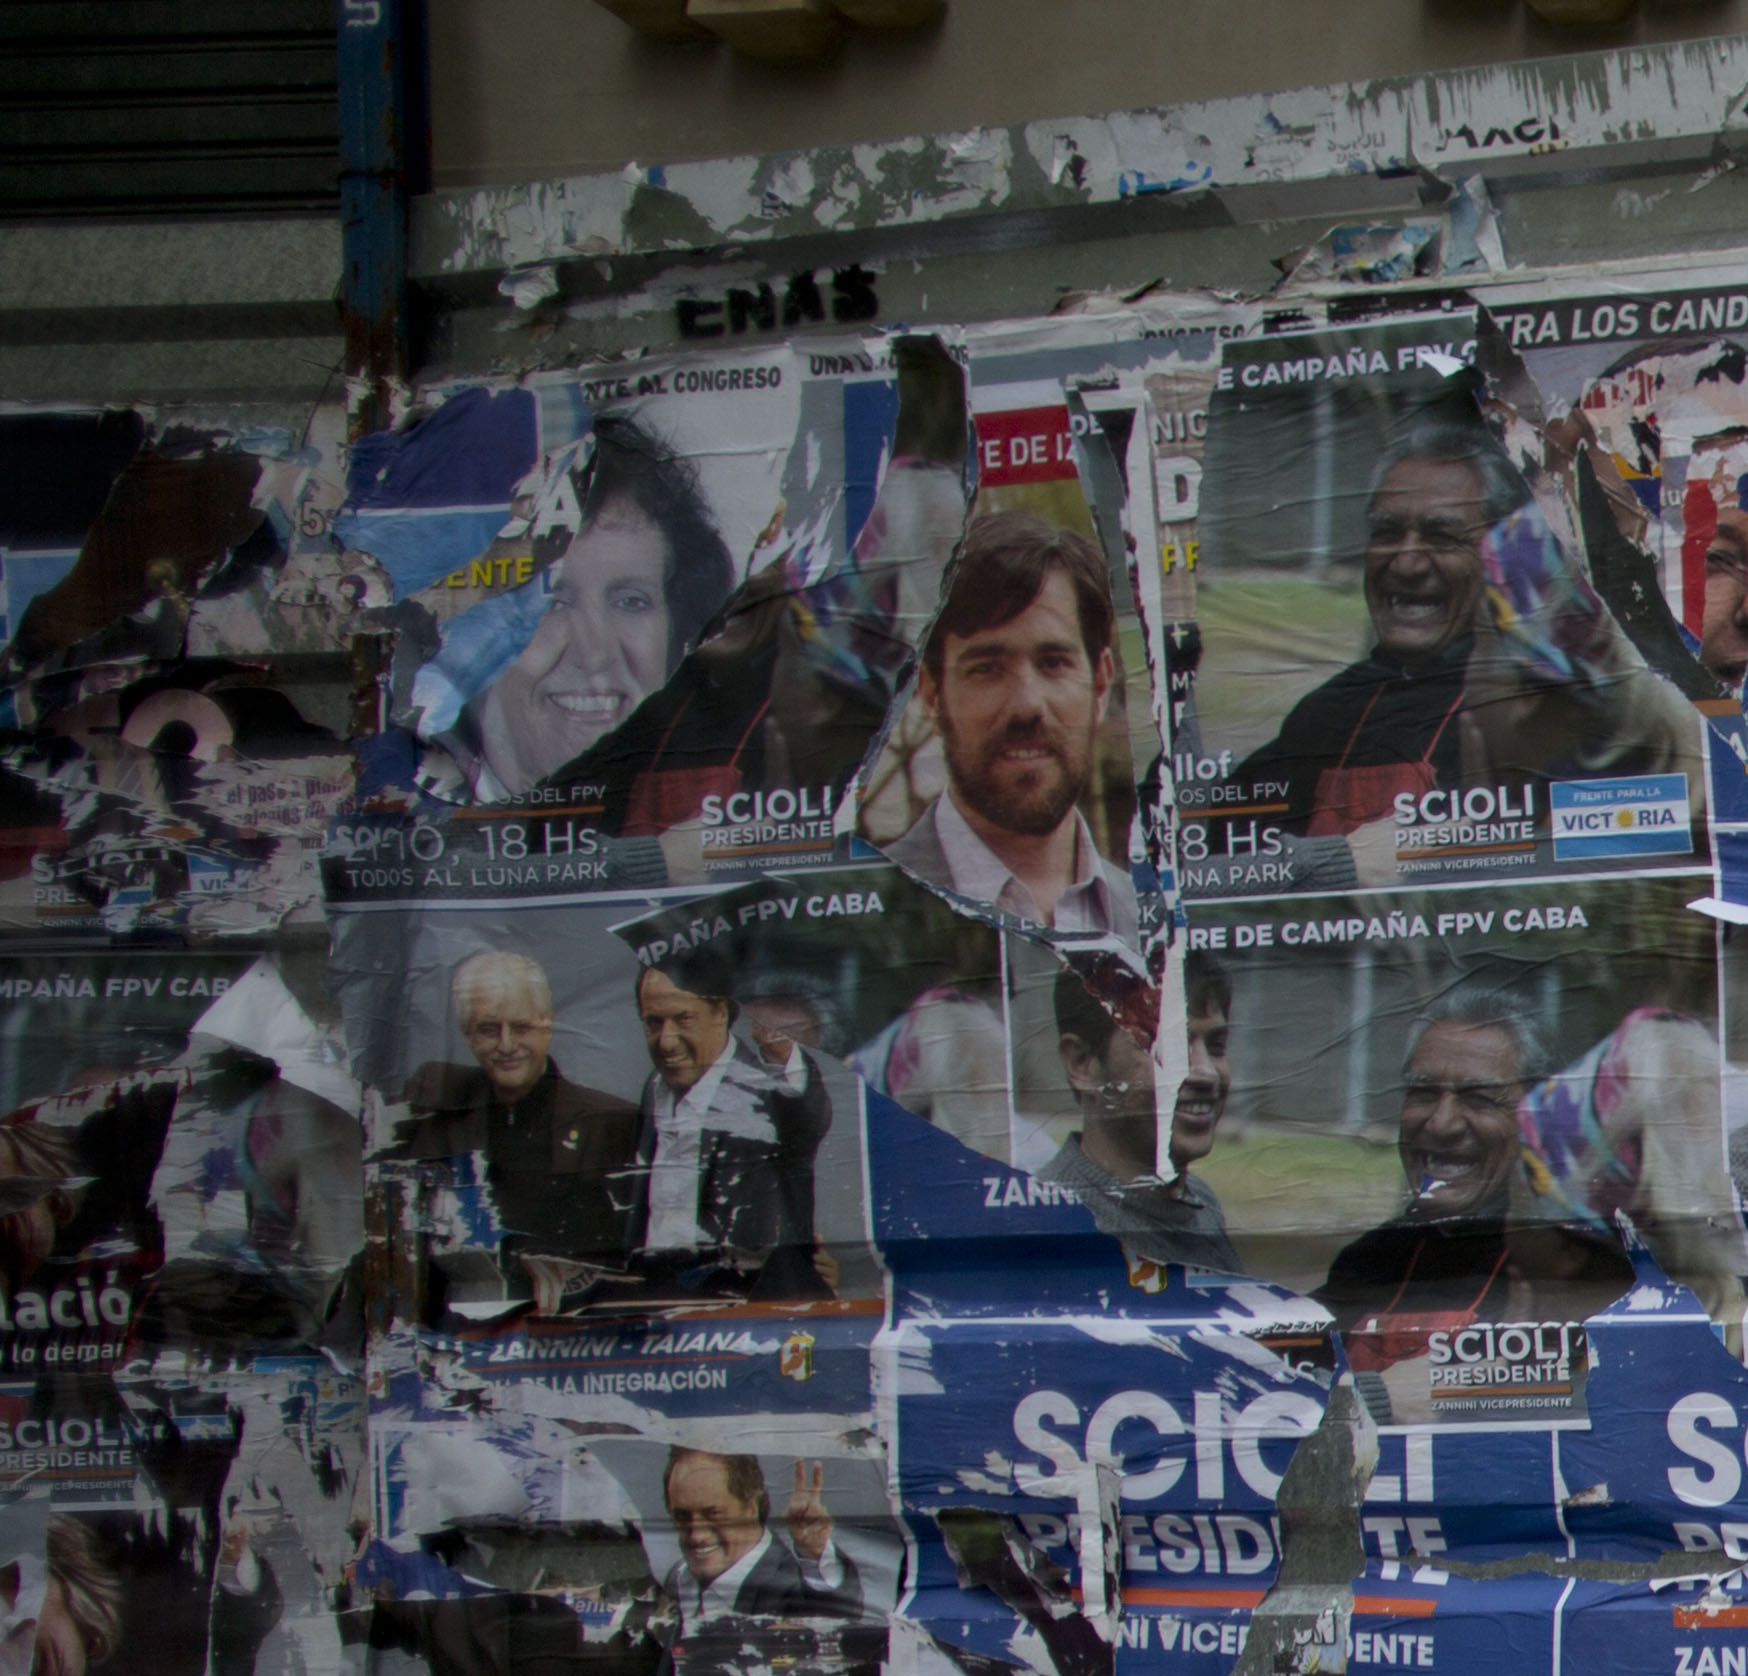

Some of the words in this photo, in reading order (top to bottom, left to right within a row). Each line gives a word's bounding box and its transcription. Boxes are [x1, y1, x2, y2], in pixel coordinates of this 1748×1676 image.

[1571, 303, 1640, 343] LOS
[673, 366, 783, 395] CONGRESO
[1242, 346, 1388, 388] CAMPAÑA
[1009, 434, 1051, 467] DE
[570, 782, 607, 801] FPV
[700, 783, 834, 825] SCIOLI
[1218, 784, 1254, 804] DEL
[1257, 781, 1290, 801] FPV
[1394, 784, 1534, 826] SCIOLI
[1616, 787, 1646, 801] PARA
[1648, 785, 1662, 798] LA
[478, 824, 528, 862] 18
[543, 821, 610, 857] Hs.
[700, 815, 834, 847] PRESIDENTE
[1224, 818, 1296, 858] Hs.
[1394, 821, 1535, 848] PRESIDENTE
[345, 867, 415, 889] TODOS
[423, 867, 462, 887] AL
[471, 866, 540, 887] LUNA
[548, 861, 610, 882] PARK
[1228, 863, 1296, 886] PARK
[738, 895, 799, 928] FPV
[805, 890, 884, 918] CABA
[1235, 922, 1275, 948] DE
[1280, 909, 1426, 946] CAMPAÑA
[1437, 907, 1495, 937] FPV
[1503, 904, 1589, 932] CABA
[105, 975, 163, 998] FPV
[1429, 1330, 1570, 1363] SCIOLI
[583, 1364, 727, 1395] INTEGRACIÓN
[1429, 1362, 1570, 1384] PRESIDENTE
